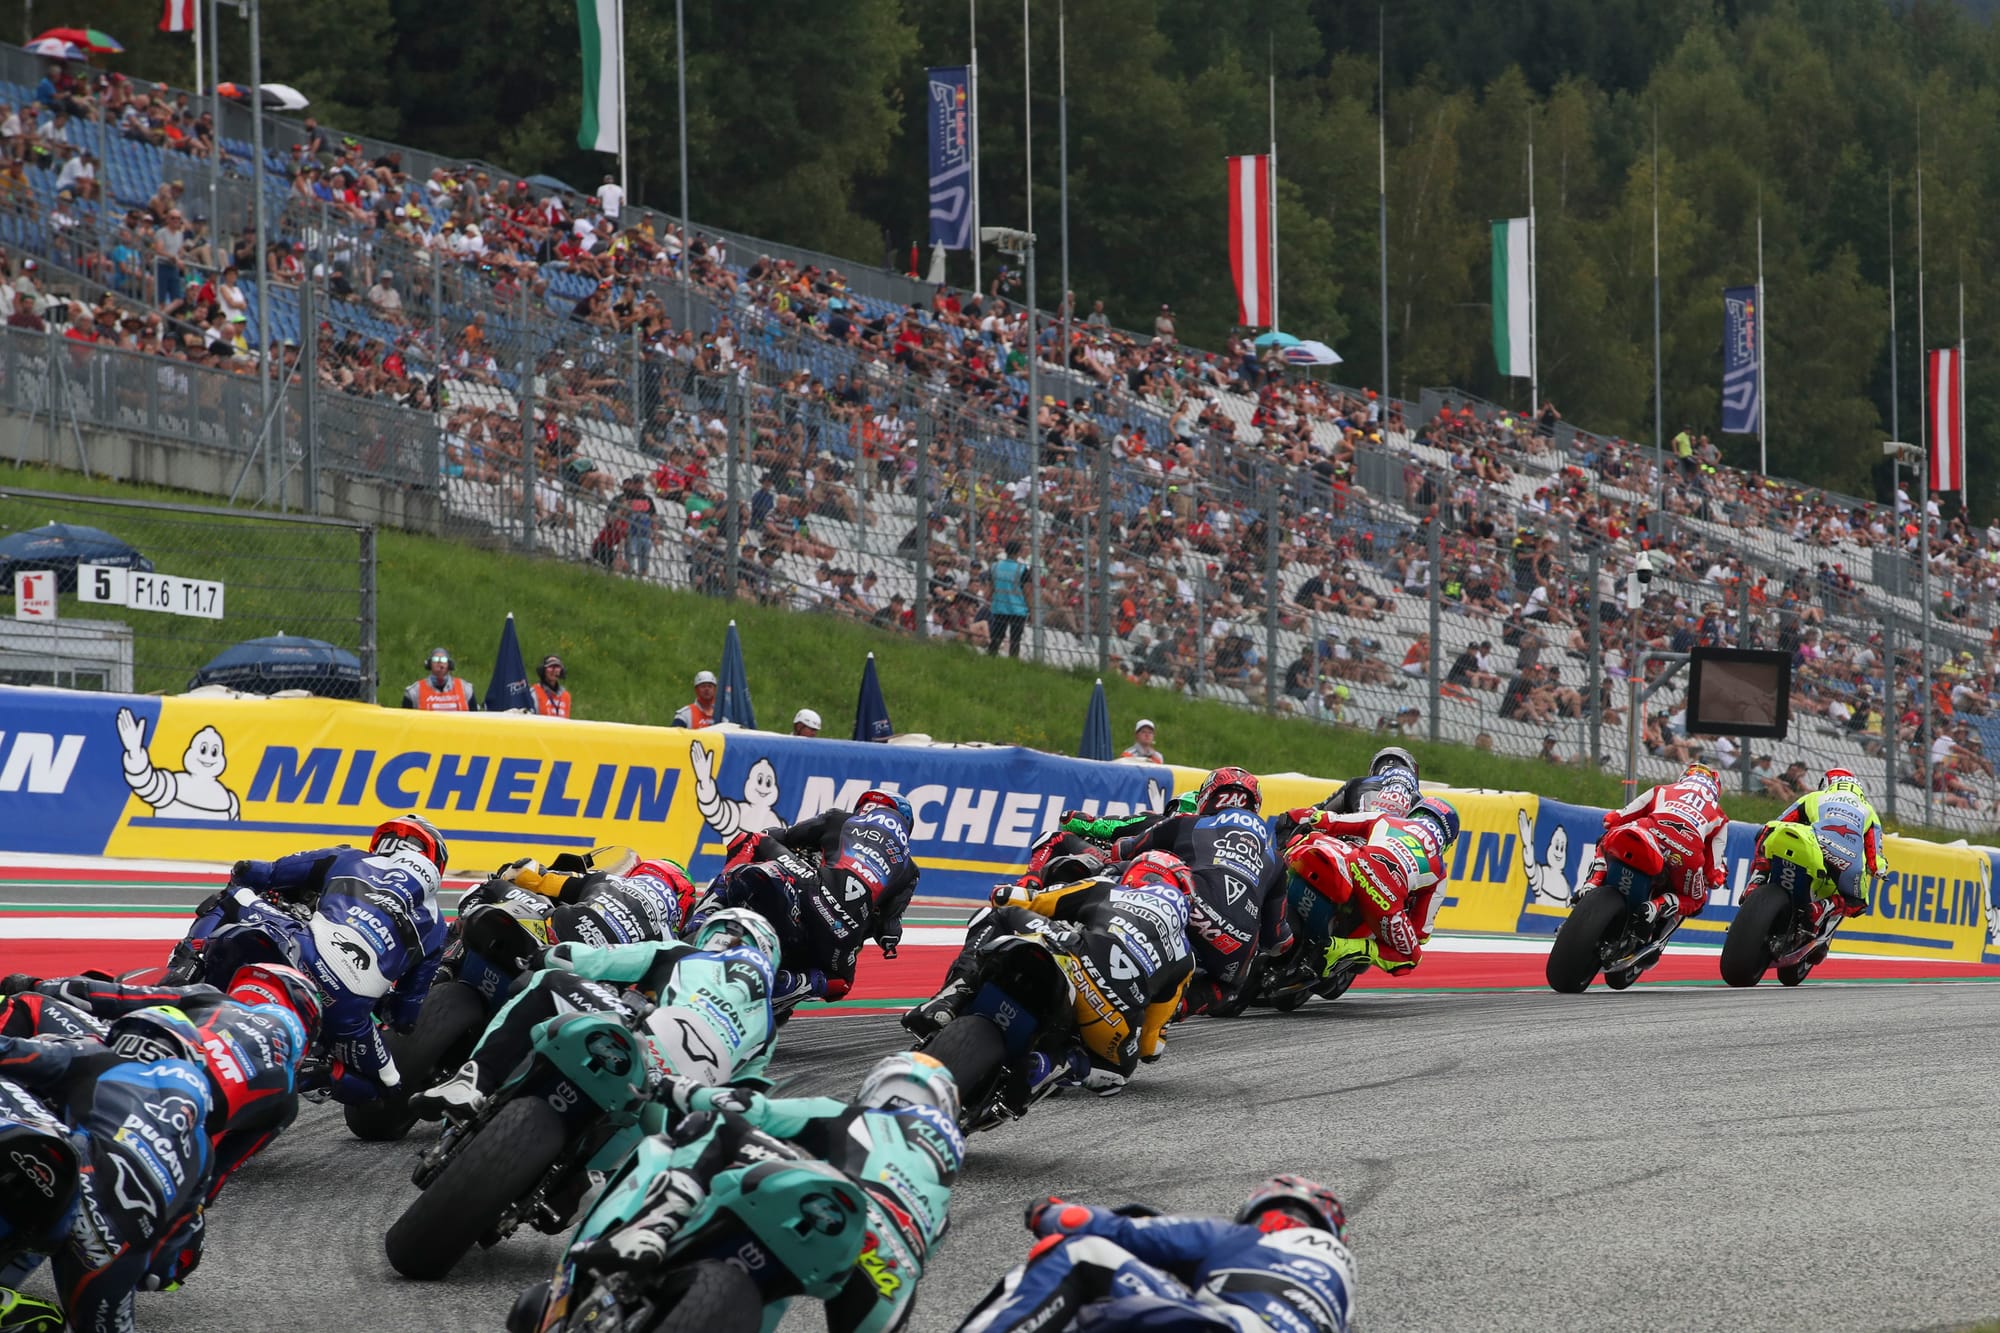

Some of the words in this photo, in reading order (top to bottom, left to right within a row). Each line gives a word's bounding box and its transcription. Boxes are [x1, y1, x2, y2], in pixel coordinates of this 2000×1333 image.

[95, 568, 111, 600] 5
[136, 577, 170, 607] F1.6
[182, 583, 217, 613] T1.7
[0, 730, 86, 794] N
[246, 745, 681, 823] MICHELIN
[1216, 793, 1248, 808] ZAC
[1378, 791, 1411, 810] MOLY
[1666, 802, 1707, 825] DUCATI
[1680, 792, 1706, 811] 40
[851, 828, 884, 844] MSI
[1213, 839, 1264, 869] CLOUD
[1387, 838, 1418, 872] DUCATI
[852, 843, 892, 876] DUCATI
[1215, 849, 1261, 875] DUCATI
[594, 895, 641, 943] DUCATI
[1195, 895, 1227, 926] UGEN
[1224, 923, 1253, 943] RACE
[1866, 870, 1981, 927] ICHELIN
[346, 905, 397, 952] DUCATI
[1109, 915, 1163, 970] DUCATI
[729, 962, 765, 994] KLINT
[232, 1008, 274, 1030] MSI
[694, 987, 747, 1038] DUCATI
[203, 1039, 245, 1084] MT
[235, 1022, 274, 1069] DUCATI
[123, 1113, 186, 1187] DUCATI
[10, 1150, 55, 1199] CLOUD
[79, 1173, 122, 1255] MACNA
